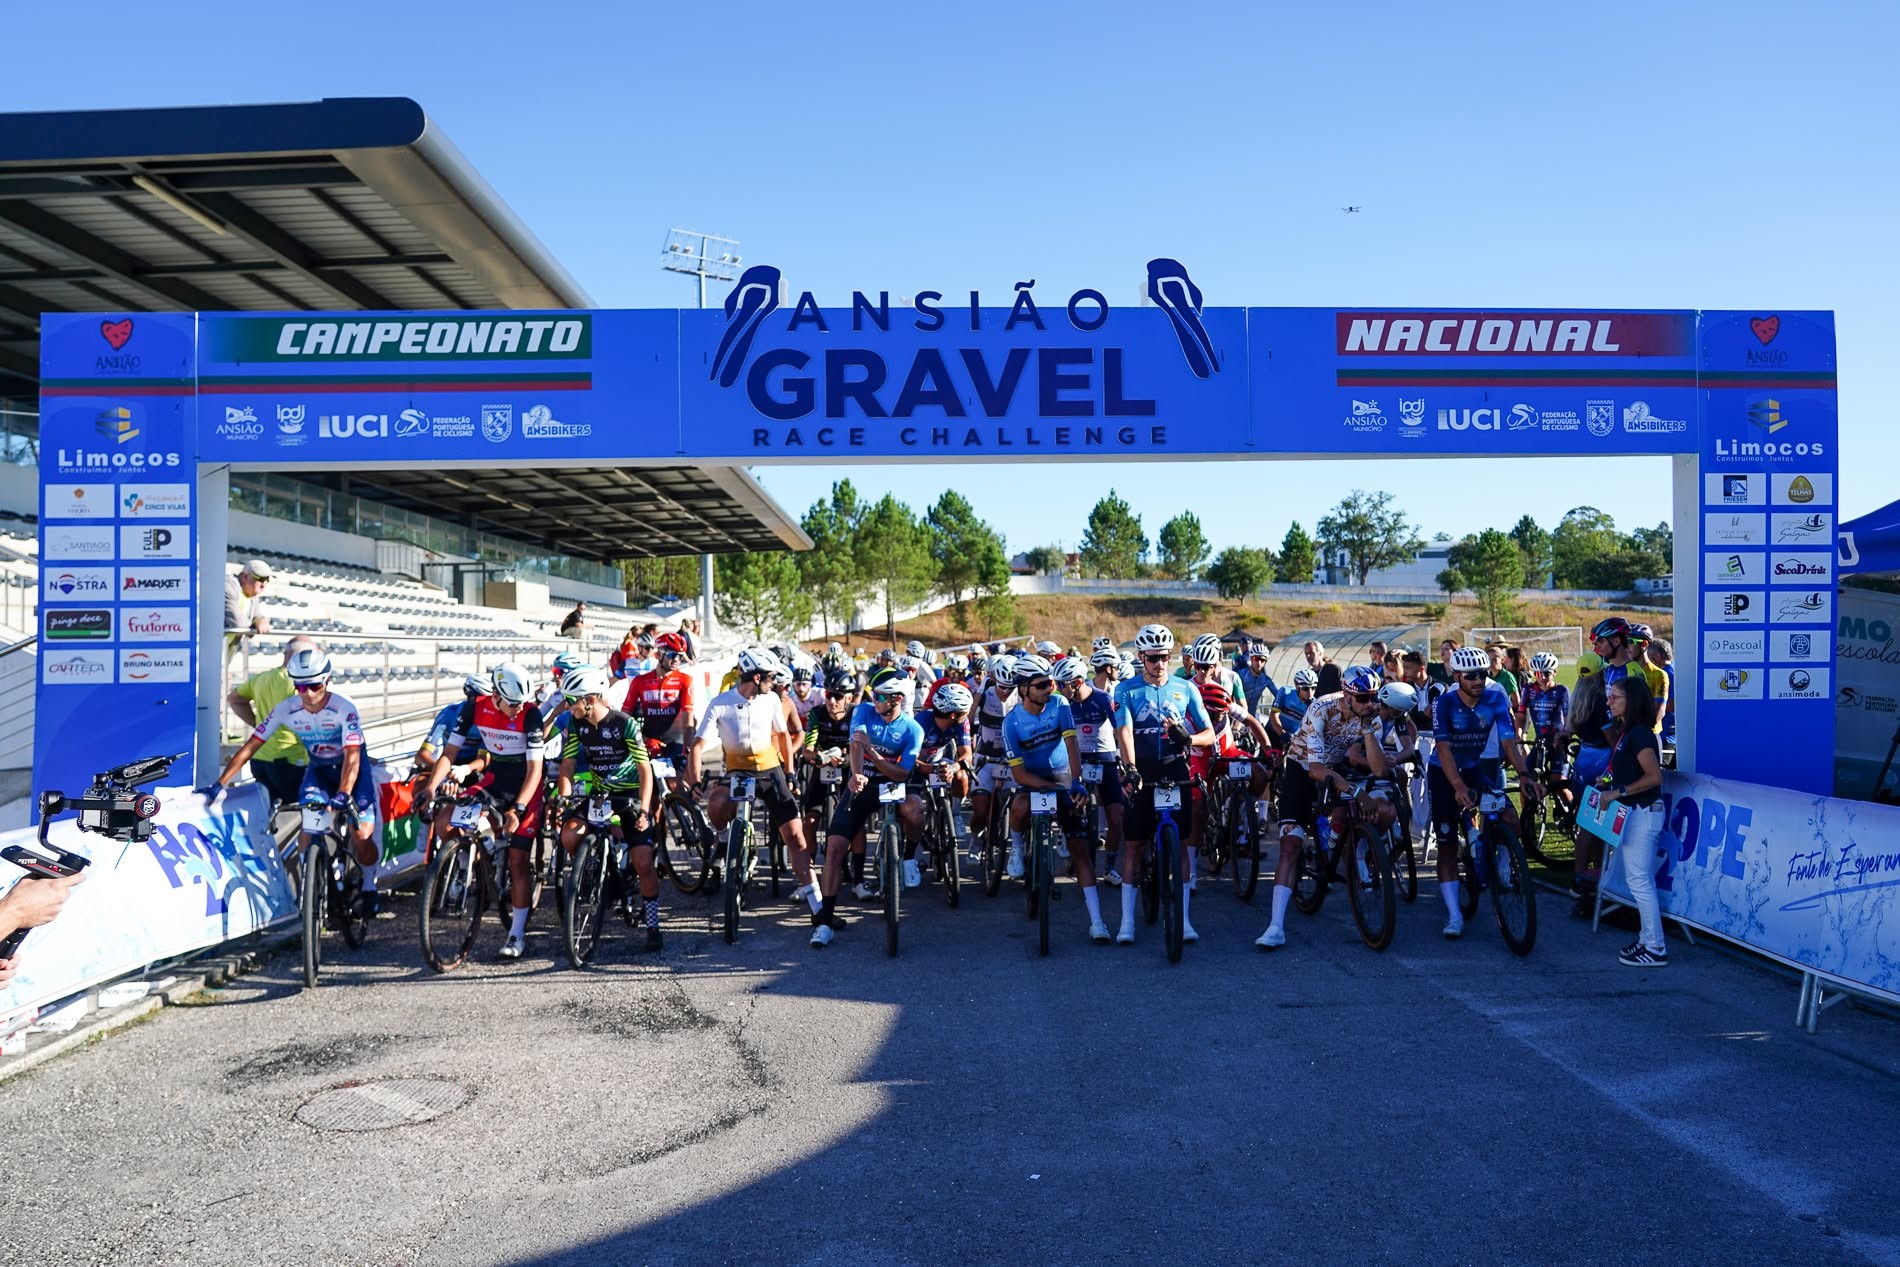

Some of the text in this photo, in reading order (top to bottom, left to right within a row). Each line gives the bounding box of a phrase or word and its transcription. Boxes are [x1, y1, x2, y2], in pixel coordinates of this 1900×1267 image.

[787, 279, 1109, 333] ANSIÃO
[276, 321, 583, 355] CAMPEONATO
[1345, 319, 1620, 352] NACIONAL
[746, 348, 1157, 421] GRAVEL
[433, 416, 471, 425] FEDERAÇÃO
[1343, 415, 1388, 426] ANSIÃO
[1542, 411, 1576, 419] FEDERAÇÃO
[216, 422, 264, 434] ANSIÃO
[527, 425, 592, 436] ANSIBIKERS
[1628, 420, 1686, 431] ANSIBIKERS
[753, 426, 1168, 446] RACE CHALLENGE
[1716, 439, 1824, 456] Limocos
[58, 449, 181, 467] Limocos
[144, 528, 152, 551] FULL
[1724, 594, 1732, 615] FULL
[50, 613, 103, 630] pingo doce
[128, 616, 183, 632] frutorra
[1722, 640, 1762, 650] Pascoal
[1836, 638, 1900, 665] escola
[1778, 690, 1820, 698] ansimoda
[1236, 766, 1246, 775] 10
[1041, 798, 1047, 807] 3
[1165, 794, 1171, 803] 2
[460, 810, 472, 820] 24
[593, 809, 604, 818] 14
[314, 818, 320, 827] 7
[1786, 851, 1821, 888] Fonte
[1818, 848, 1832, 878] de
